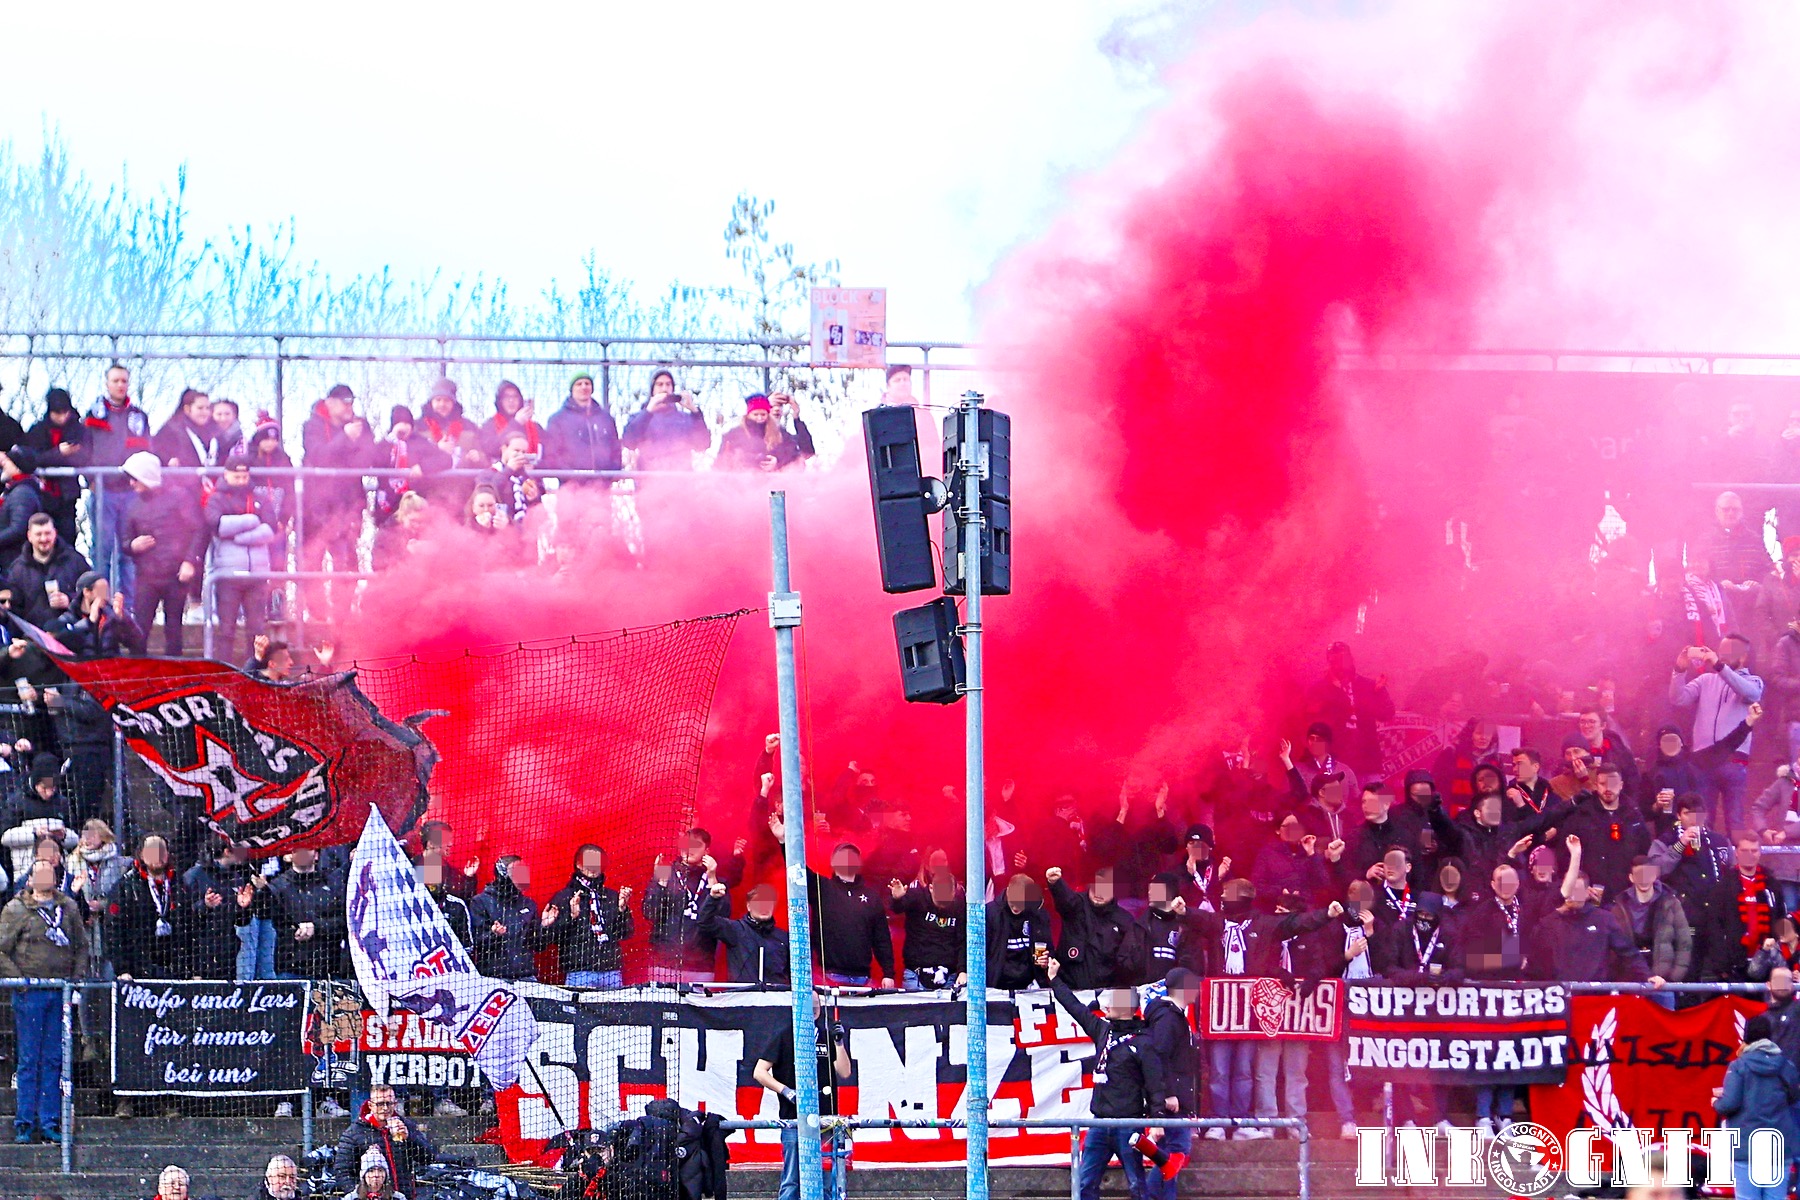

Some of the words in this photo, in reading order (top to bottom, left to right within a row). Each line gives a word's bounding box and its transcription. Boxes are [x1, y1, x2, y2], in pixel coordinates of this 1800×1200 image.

[812, 290, 859, 304] BLOCK
[925, 911, 936, 922] 19
[947, 917, 957, 927] 13
[121, 983, 186, 1018] Mofo
[191, 987, 243, 1010] und
[248, 985, 298, 1013] Lars
[1348, 985, 1566, 1017] SUPPORTERS
[144, 1023, 187, 1055] für
[192, 1026, 275, 1046] immer
[1347, 1035, 1568, 1070] INGOLSTADT
[164, 1061, 203, 1084] bei
[207, 1066, 258, 1084] uns
